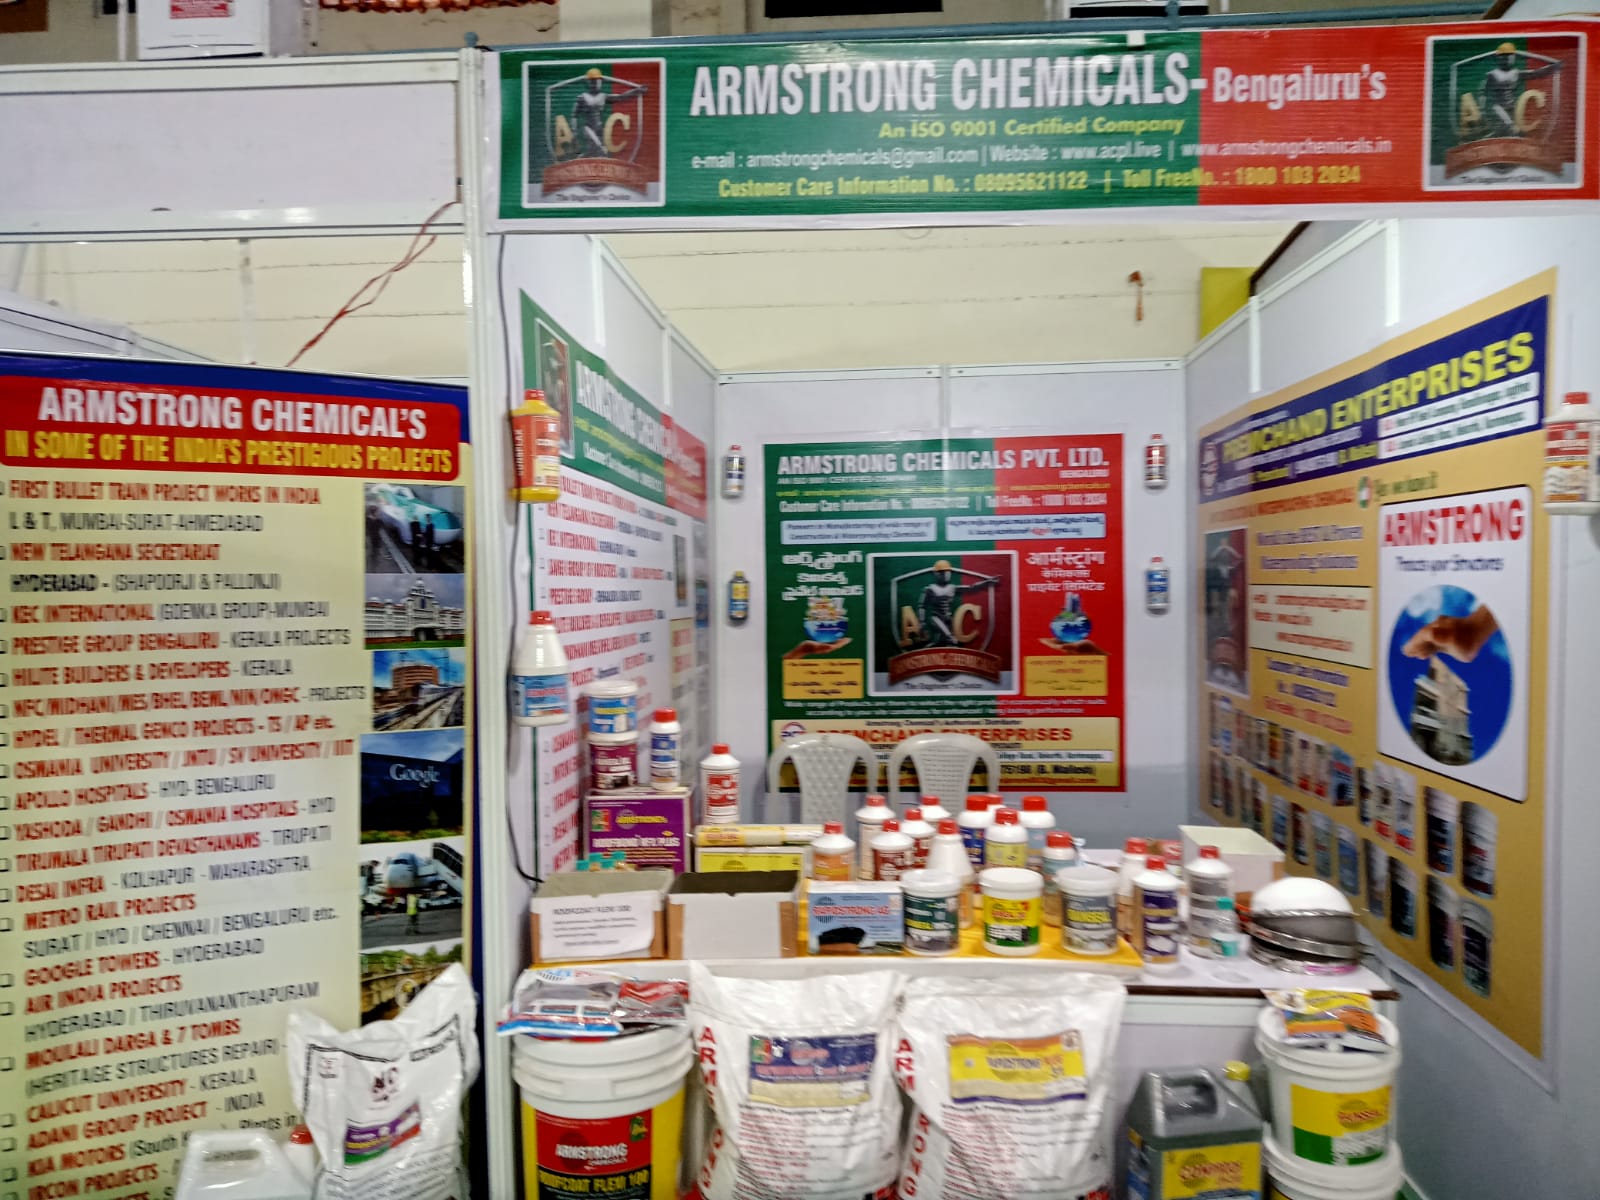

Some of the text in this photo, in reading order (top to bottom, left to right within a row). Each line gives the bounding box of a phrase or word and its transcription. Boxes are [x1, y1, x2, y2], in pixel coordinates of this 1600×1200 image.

[689, 59, 937, 117] ARMSTRONG
[1213, 64, 1387, 110] Bengaluru's
[878, 116, 1185, 138] An ISO 9001 Certified Company
[691, 151, 735, 168] e-mail
[746, 146, 978, 170] armstrongchemicals@gmail.com
[990, 143, 1048, 162] Website
[1181, 137, 1392, 159] www.armstrongchemicals.in
[719, 179, 792, 197] Customer
[797, 177, 833, 196] Care
[838, 175, 929, 195] Information
[1122, 169, 1152, 187] Toll
[1331, 331, 1535, 430] ENTERPRISES
[38, 387, 427, 440] ARMSTRONG CHEMICAL'S
[5, 429, 453, 473] IN SOME OF THE INDIA'S PRESTIGIOUS PROJECTS
[776, 447, 1110, 475] ARMSTRONG CHEMICALS PVT. LTD.
[9, 479, 321, 504] FIRST BULLET TRAIN PROJECT WORKS IN INDIA
[1381, 498, 1525, 547] ARMSTRONG
[10, 542, 221, 561] NEW TELANGANA SECRETARIAT
[10, 574, 98, 592] HYDERABAD
[11, 605, 39, 624] KEC
[44, 603, 155, 623] INTERNATIONAL
[953, 603, 982, 643] C
[12, 628, 351, 655] PRESTIGE GROUP BENGALURU KERALA PROJECTS
[63, 665, 130, 684] BUILDERS
[148, 660, 231, 680] DEVELOPERS
[241, 658, 293, 677] KERALA
[13, 728, 60, 748] HYDEL
[74, 723, 139, 745] THERMAL
[142, 721, 189, 740] GENCO
[192, 717, 255, 738] PROJECTS
[14, 758, 84, 779] OSMANIA
[90, 751, 169, 774] UNIVERSITY
[182, 748, 217, 767] JNTU
[248, 741, 322, 763] UNIVERSITY
[15, 789, 72, 811] APOLLO
[73, 782, 148, 805] HOSPITALS
[195, 774, 276, 795] BENGALURU
[15, 819, 82, 841] YASHODA
[97, 812, 152, 833] GANDHI
[166, 806, 228, 827] OSMANIA
[231, 799, 299, 821] HOSPITALS
[16, 824, 332, 872] TIRUMALA TIRUPATI DEVASTHANAMS TIRUPATI
[16, 855, 311, 903] DESAI INFRA KOLHAPUR MAHARASHTRA
[23, 893, 197, 931] METRO RAIL PROJECTS
[23, 933, 82, 959] SURAT
[95, 927, 130, 947] HYD
[141, 918, 210, 942] CHENNAI
[222, 907, 310, 932] BENGALURU
[24, 938, 265, 987] GOOGLE TOWERS HYDERABAD
[24, 981, 320, 1042] HYDERABAD THIRUVANANTHAPURAM
[25, 975, 183, 1015] AIR INDIA PROJECTS
[25, 1039, 99, 1070] MOULALI
[103, 1031, 157, 1055] DARGA
[191, 1018, 241, 1041] TOMBS
[115, 1047, 220, 1080] STRUCTURES
[26, 1067, 257, 1123] CALICUT UNIVERSITY KERALA
[27, 1091, 266, 1150] ADANI GROUP PROJECT INDIA
[27, 1154, 56, 1178] KIA
[60, 1143, 127, 1170] MOTORS
[555, 1142, 628, 1160] ARMSTRONG
[84, 1163, 160, 1194] PROJECTS
